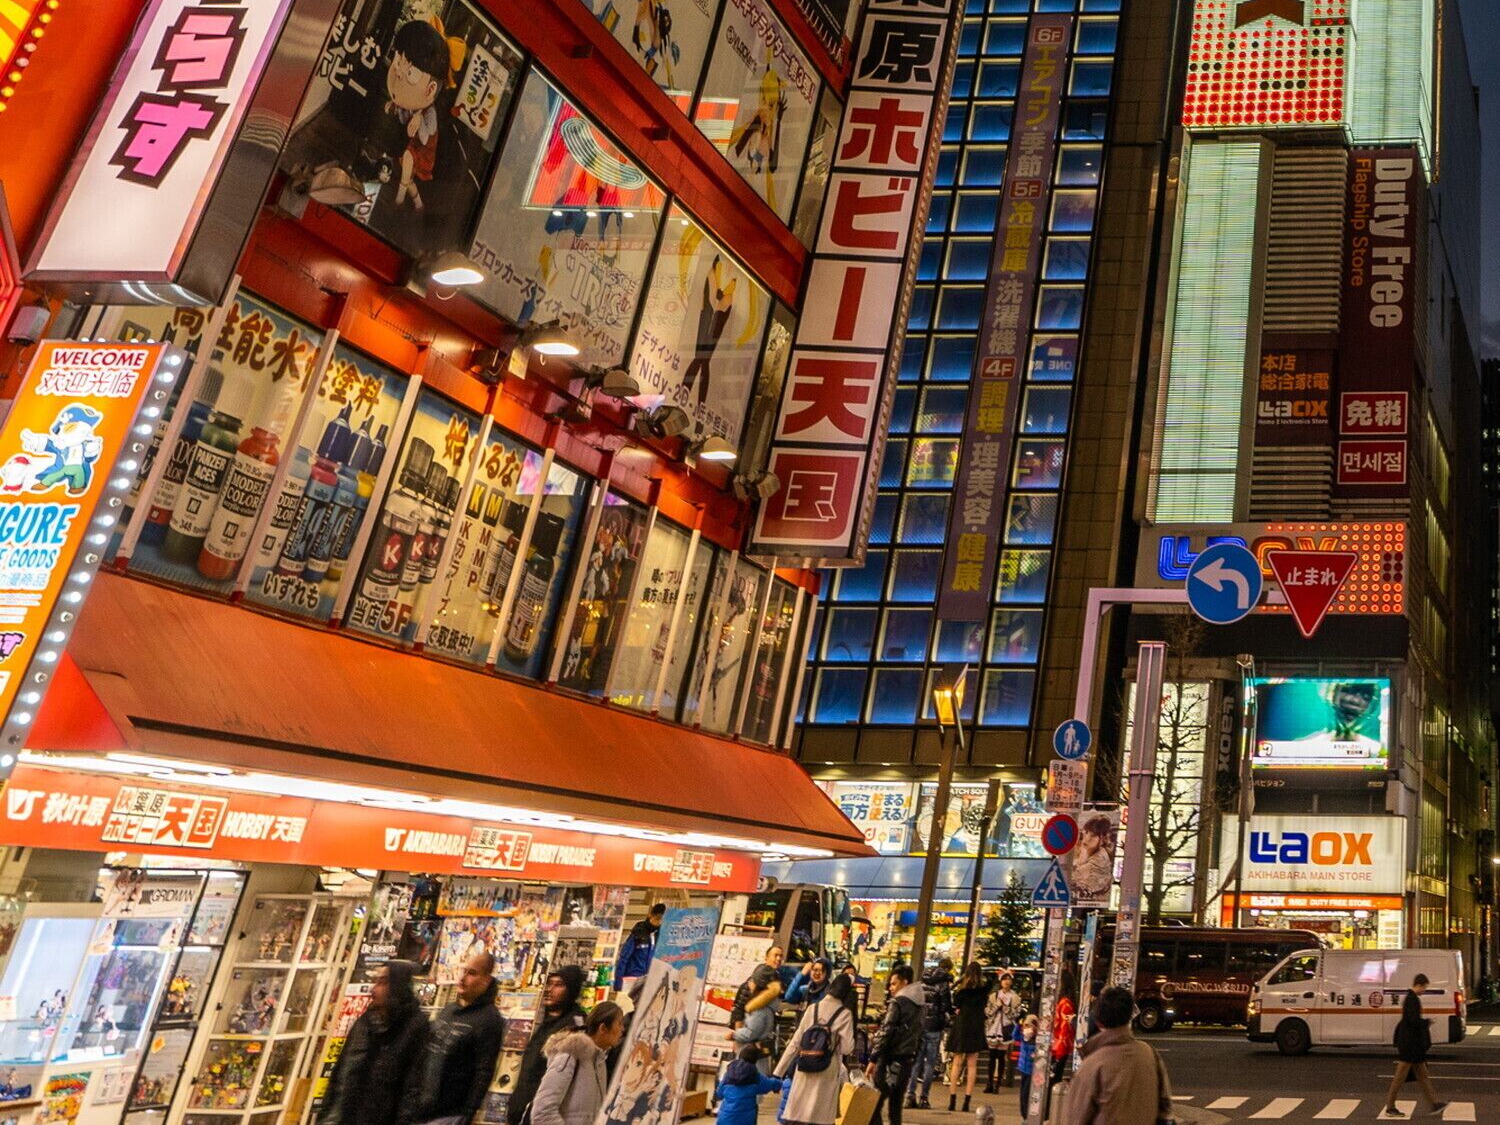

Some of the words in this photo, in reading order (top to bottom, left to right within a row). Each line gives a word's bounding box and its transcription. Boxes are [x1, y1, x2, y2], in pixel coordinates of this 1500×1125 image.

[1033, 26, 1064, 45] 6F
[1012, 181, 1041, 199] 5F
[1351, 158, 1372, 232] Flagship
[1370, 158, 1413, 239] Duty
[1350, 234, 1370, 287] Store
[987, 200, 1036, 358] 冷蔵庫・洗濯機
[1370, 246, 1412, 328] Free
[53, 348, 146, 369] WELCOME
[984, 359, 1015, 377] 4F
[1262, 354, 1296, 371] 本店
[37, 371, 137, 397] 欢迎光临
[1345, 399, 1404, 427] 免税
[196, 448, 226, 471] PANZER
[1342, 451, 1403, 474] 면세점
[194, 464, 216, 485] ACES
[230, 469, 266, 495] MODEL
[225, 486, 261, 509] COLOR
[7, 549, 57, 570] GOODS
[1284, 569, 1339, 588] 止まれ
[262, 571, 319, 610] いずれも
[42, 796, 112, 827] 秋叶原
[221, 812, 273, 841] HOBBY
[402, 829, 468, 858] AKIHABARA
[528, 841, 560, 865] HOBBY
[1248, 870, 1308, 881] AKIHABARA
[1309, 871, 1336, 881] MAIN
[1338, 871, 1373, 882] STORE
[150, 888, 197, 905] GRIDMAN
